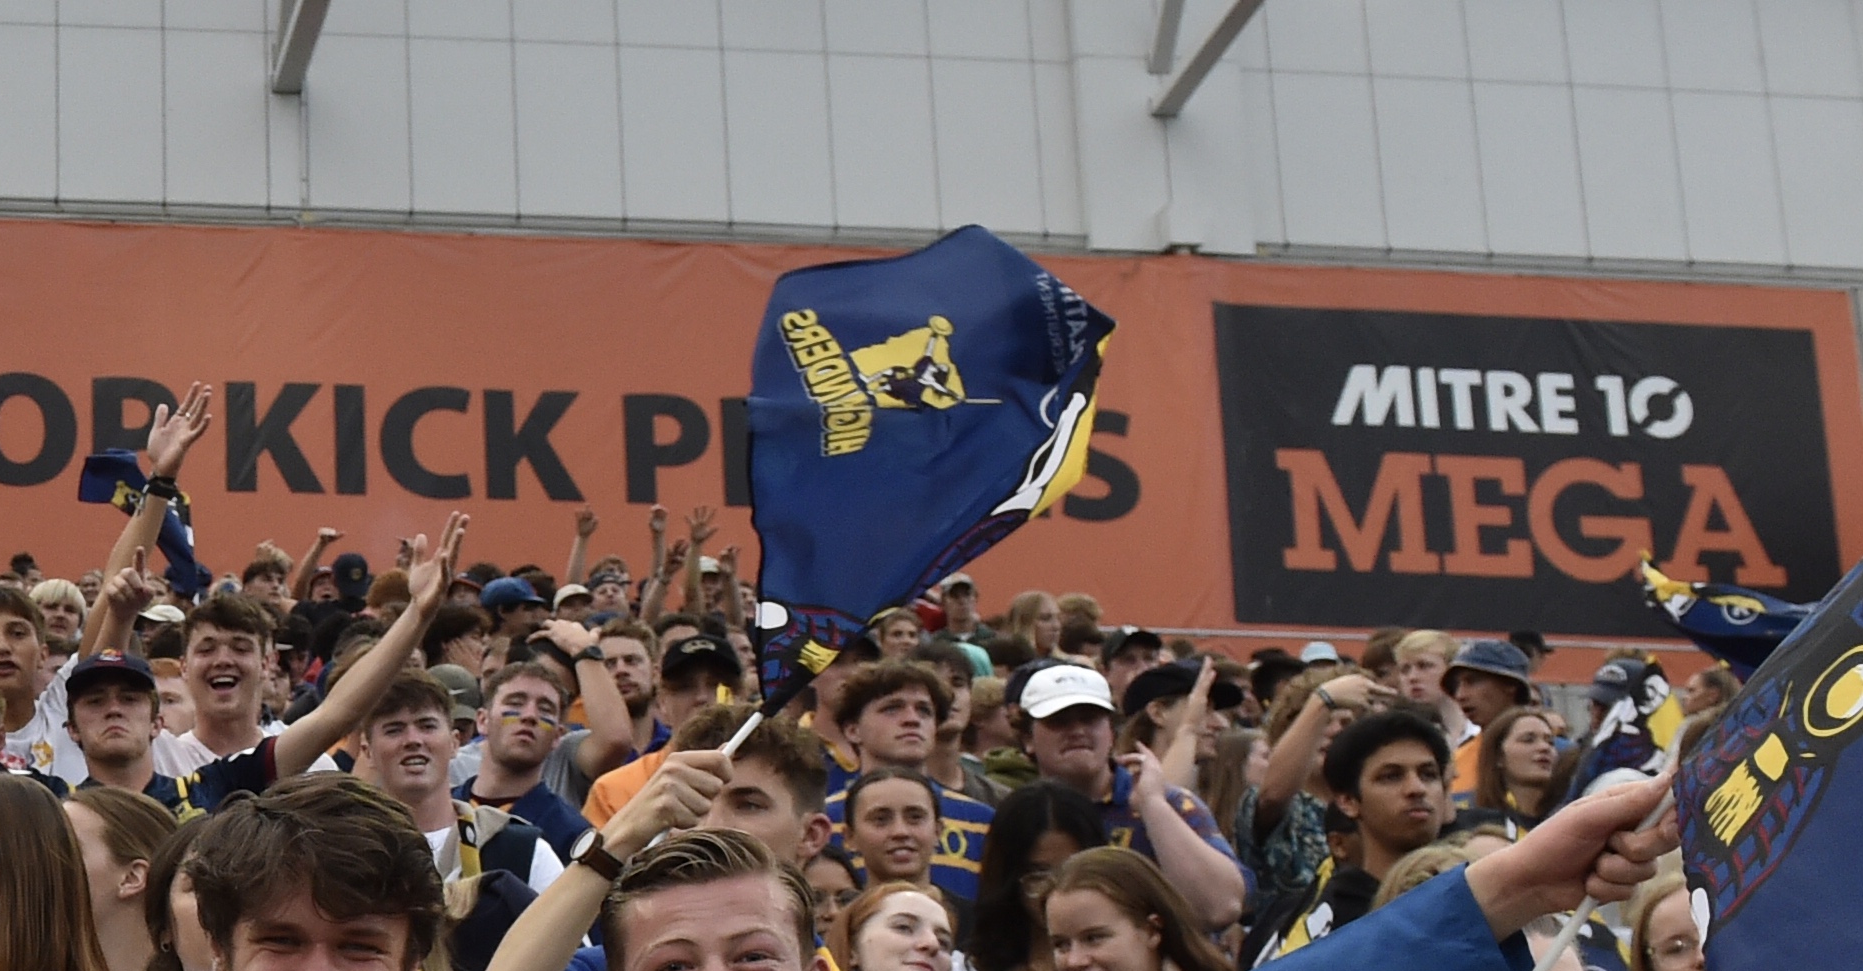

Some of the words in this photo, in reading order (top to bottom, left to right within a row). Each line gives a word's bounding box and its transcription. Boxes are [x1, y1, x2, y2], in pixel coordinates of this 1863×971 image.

[223, 381, 586, 501] KICK
[1331, 364, 1579, 434] MITRE
[1595, 374, 1695, 439] 10
[1274, 448, 1788, 588] MEGA
